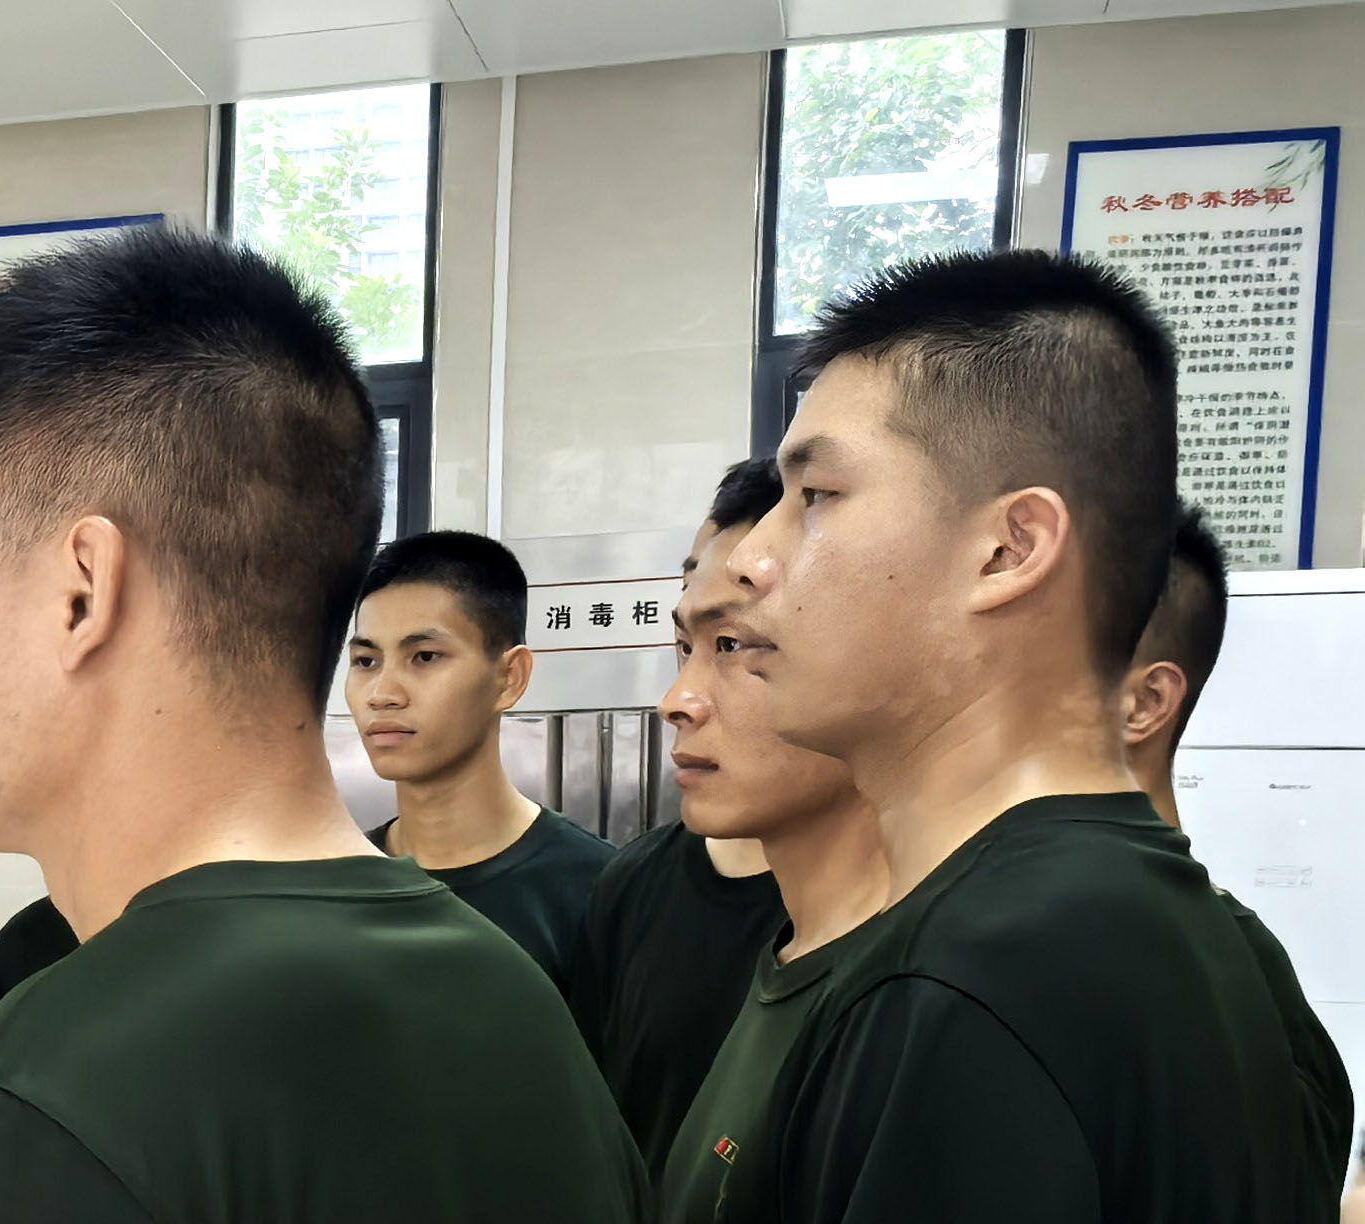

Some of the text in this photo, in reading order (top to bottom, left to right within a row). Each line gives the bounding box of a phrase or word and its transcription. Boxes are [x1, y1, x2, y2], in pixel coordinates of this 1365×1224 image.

[1101, 186, 1295, 214] 秋冬营养搭配
[546, 600, 659, 630] 消毒柜
